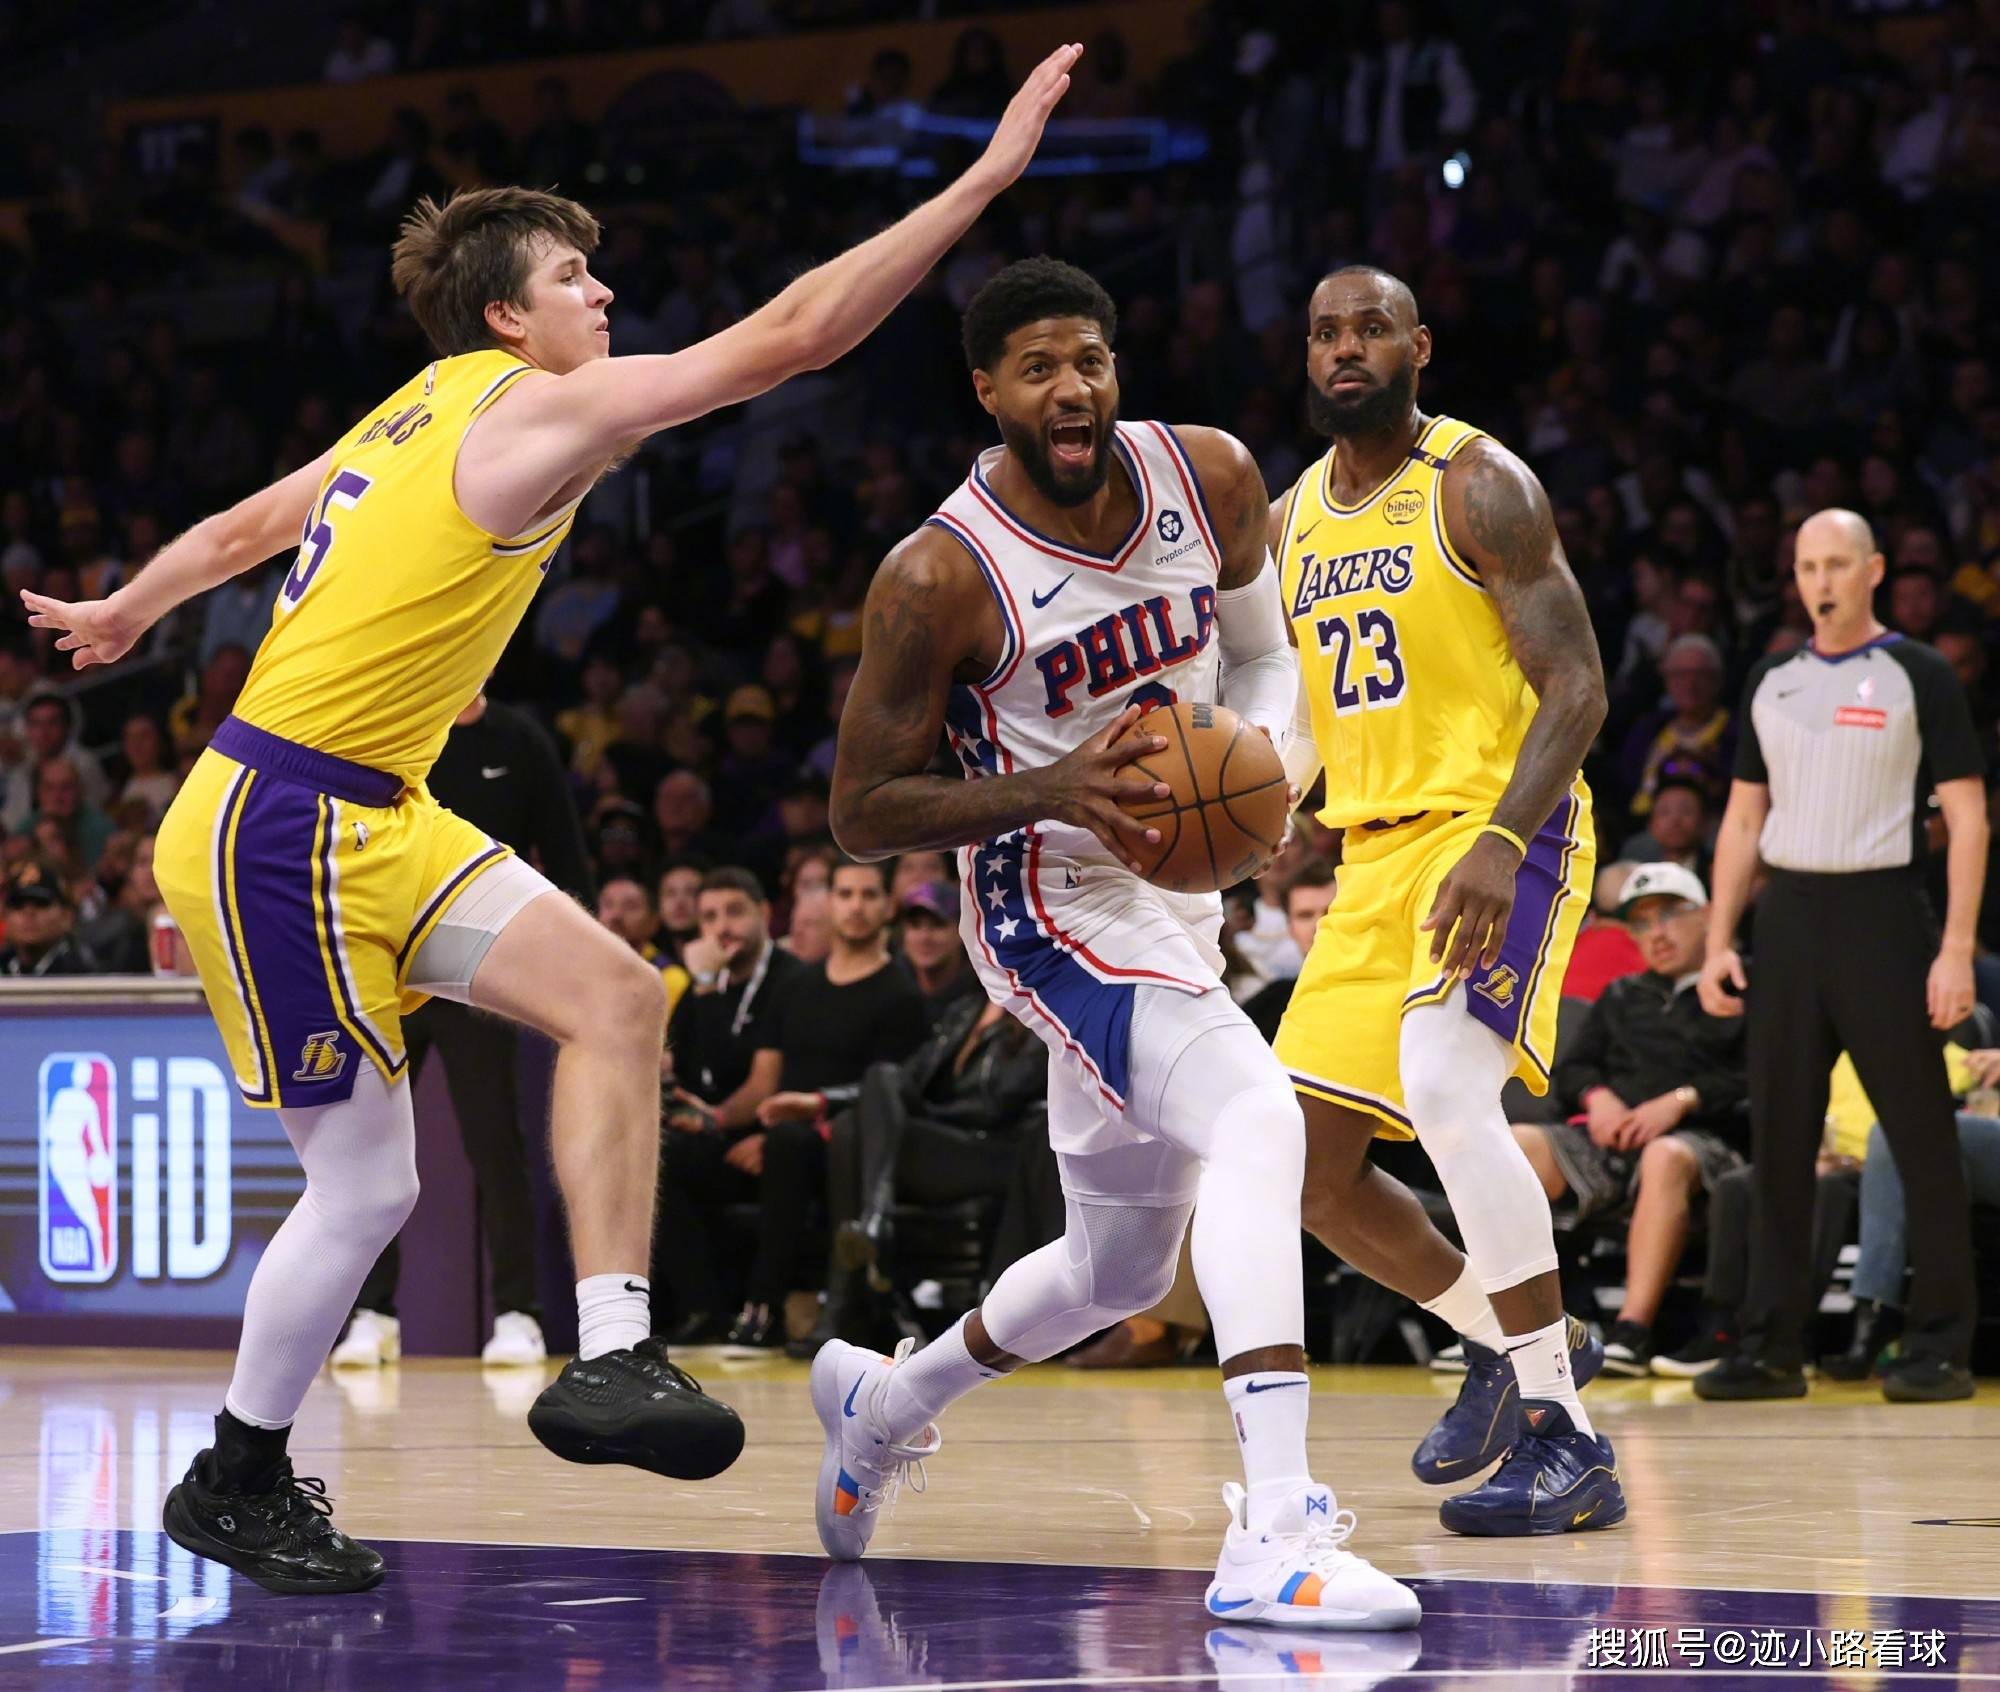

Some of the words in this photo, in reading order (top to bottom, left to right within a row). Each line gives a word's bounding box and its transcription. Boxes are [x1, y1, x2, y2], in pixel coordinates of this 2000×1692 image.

[1387, 499, 1422, 513] bibigo
[1155, 538, 1202, 566] crypto.com
[1291, 545, 1414, 618] LAKERS
[1316, 608, 1407, 717] 23
